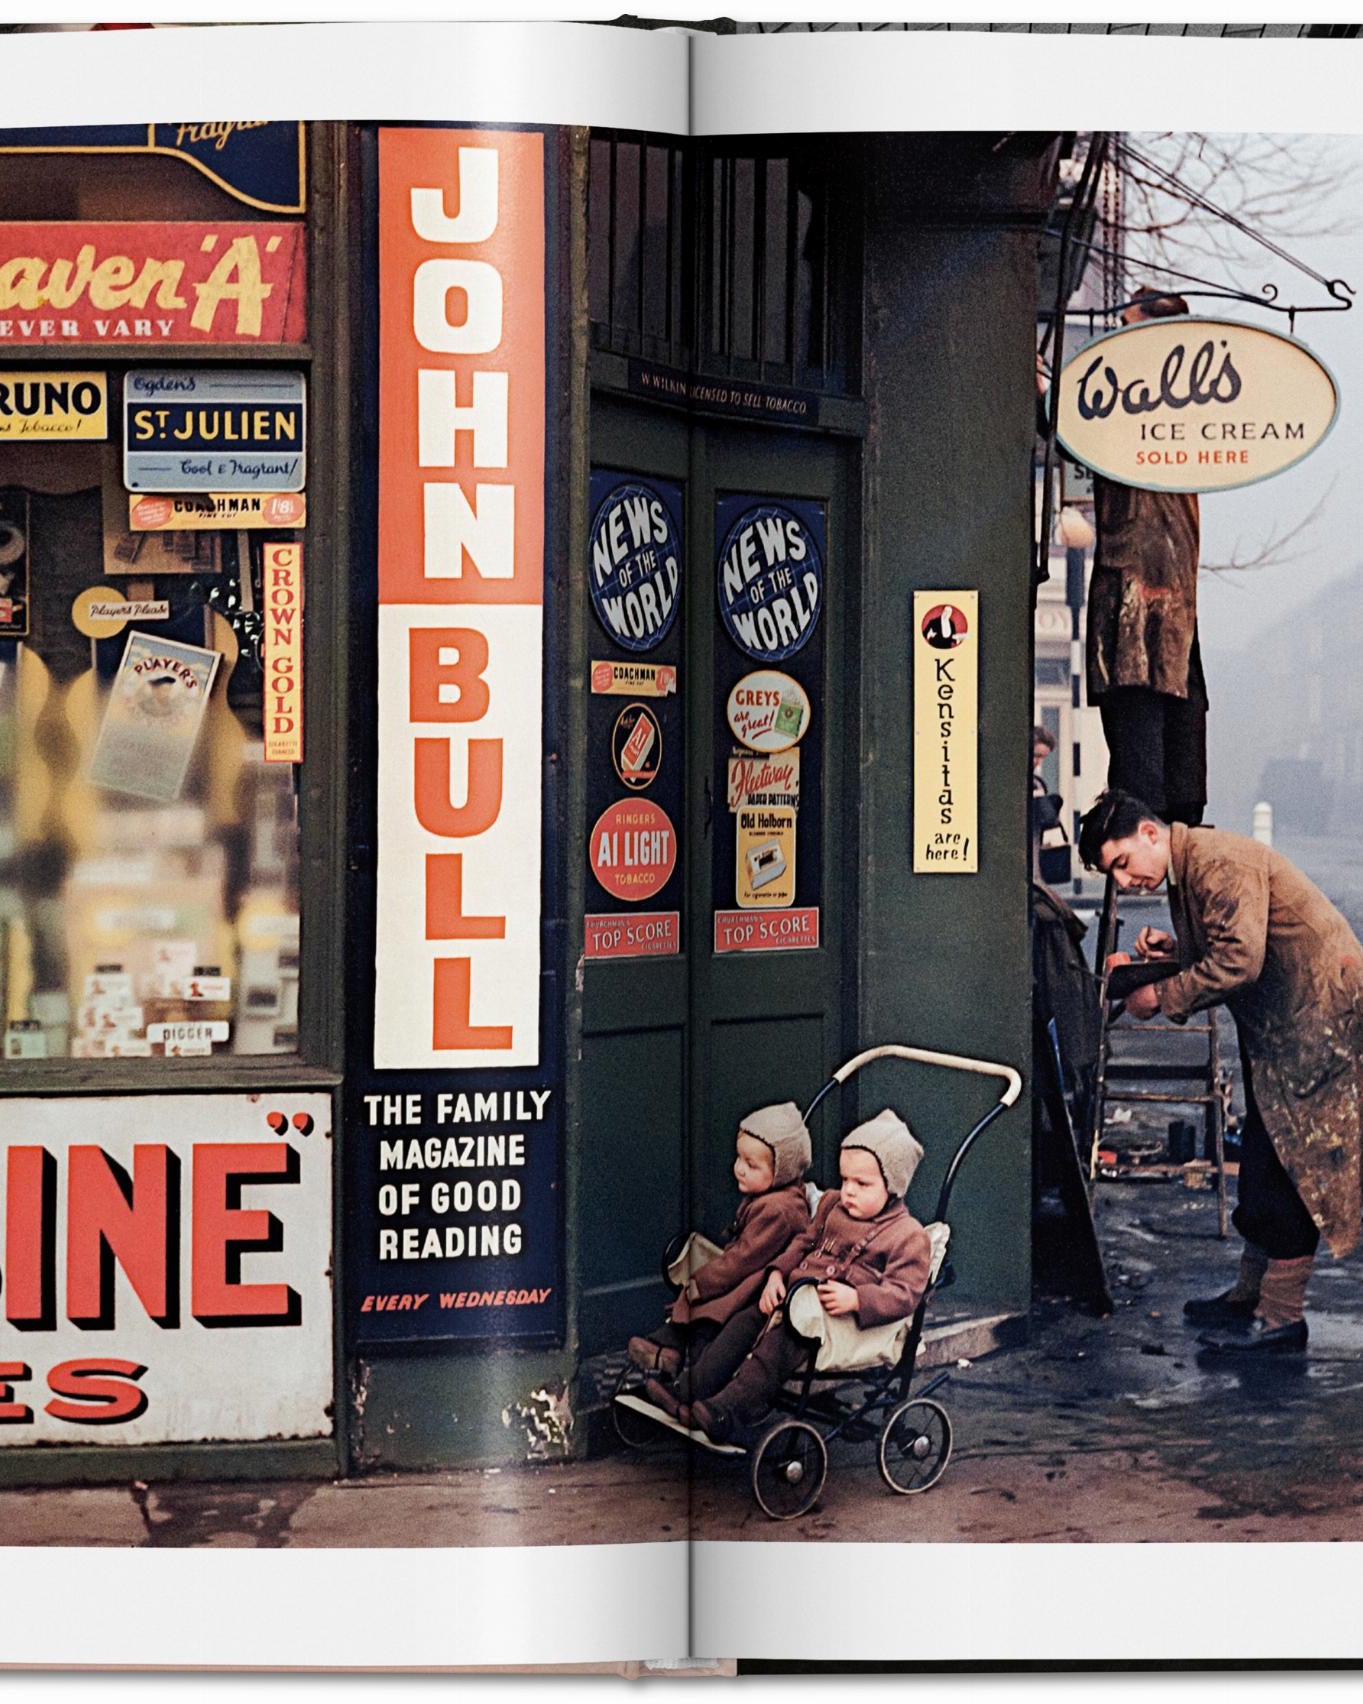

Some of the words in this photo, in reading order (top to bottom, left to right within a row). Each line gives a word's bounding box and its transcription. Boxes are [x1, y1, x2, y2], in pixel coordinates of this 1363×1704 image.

[91, 319, 175, 337] VARY
[410, 146, 515, 579] JOHN
[1077, 339, 1242, 421] Wall's
[653, 375, 686, 395] WILKIN
[730, 390, 742, 406] TO
[742, 393, 762, 409] SELL
[173, 410, 296, 441] JULIEN
[1140, 422, 1186, 441] ICE
[1200, 422, 1305, 441] CREAM
[180, 458, 213, 476] Cool
[229, 458, 299, 481] Fragrant!
[1136, 450, 1188, 465] SOLD
[1198, 449, 1249, 464] HERE
[593, 496, 668, 588] NEWS
[619, 566, 634, 588] OF
[635, 550, 658, 577] THE
[723, 518, 806, 605] NEWS
[270, 549, 297, 646] CROWN
[601, 556, 679, 640] WORLD
[750, 583, 765, 604] OF
[768, 567, 792, 594] THE
[732, 572, 818, 651] WORLD
[613, 667, 656, 681] COACHMAN
[271, 656, 295, 734] GOLD
[735, 689, 780, 706] GREYS
[734, 711, 749, 723] are
[934, 658, 955, 825] Kensitas
[741, 813, 755, 829] Old
[758, 812, 793, 829] Holborn
[934, 831, 961, 844] are
[408, 627, 513, 1051] BULL
[624, 830, 670, 866] LIGHT
[614, 872, 656, 886] TOBACCO
[592, 929, 621, 951] TOP
[627, 919, 672, 945] SCORE
[723, 924, 754, 945] TOP
[760, 914, 810, 940] SCORE
[163, 1027, 213, 1041] DIGGER
[363, 1094, 422, 1126] THE
[437, 1090, 551, 1124] FAMILY
[380, 1134, 526, 1171] MAGAZINE
[378, 1183, 420, 1216] OF
[431, 1179, 521, 1214] GOOD
[379, 1223, 522, 1260] READING
[361, 1293, 430, 1313] EVERY
[439, 1287, 552, 1309] WEDNESDAY
